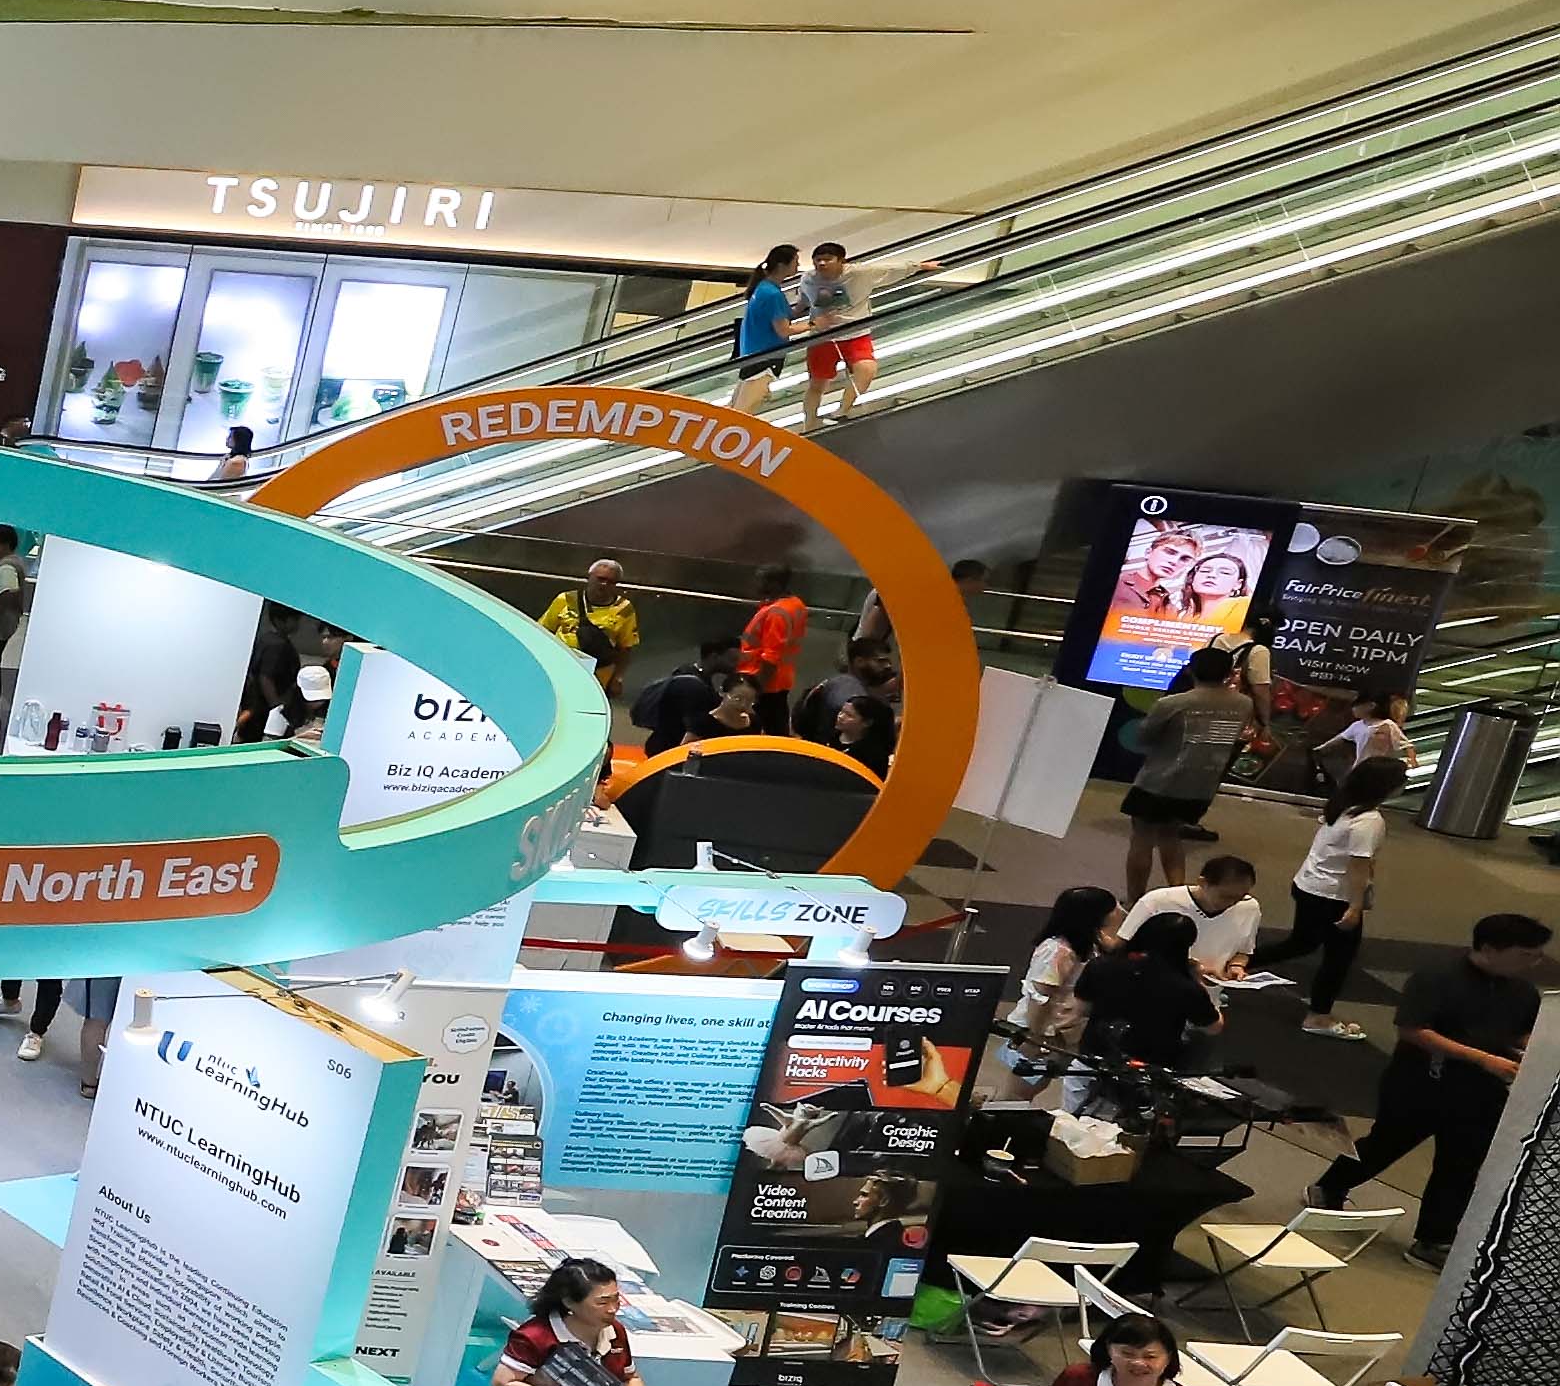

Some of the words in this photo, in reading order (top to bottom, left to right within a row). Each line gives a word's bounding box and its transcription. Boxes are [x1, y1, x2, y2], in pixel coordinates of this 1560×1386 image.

[207, 176, 498, 231] TSUJIRI
[440, 396, 792, 480] REDEMPTION
[1286, 579, 1363, 600] FairPrice
[1349, 626, 1424, 648] DAILY
[387, 764, 412, 777] Biz
[417, 765, 434, 779] IQ
[1, 858, 144, 903] North
[156, 853, 259, 899] East
[698, 898, 794, 921] SKILLS
[795, 904, 869, 924] ZONE
[602, 1012, 661, 1027] Changing
[665, 1013, 697, 1027] lives,
[701, 1017, 724, 1027] one
[728, 1017, 750, 1027] skill
[796, 999, 826, 1021] AI
[829, 1001, 942, 1023] Courses
[327, 1059, 352, 1080] S06
[785, 1065, 828, 1079] Hacks
[788, 1054, 869, 1071] Productivity
[195, 1057, 309, 1128] LearningHub
[882, 1125, 938, 1139] Graphic
[135, 1098, 183, 1135] NTUC
[187, 1127, 301, 1203] LearningHub
[888, 1136, 935, 1151] Design
[138, 1126, 287, 1220] www.ntuclearninghub.com
[757, 1184, 796, 1197] Video
[99, 1185, 133, 1214] About
[134, 1205, 151, 1224] Us
[753, 1196, 807, 1209] Content
[750, 1207, 808, 1220] Creation
